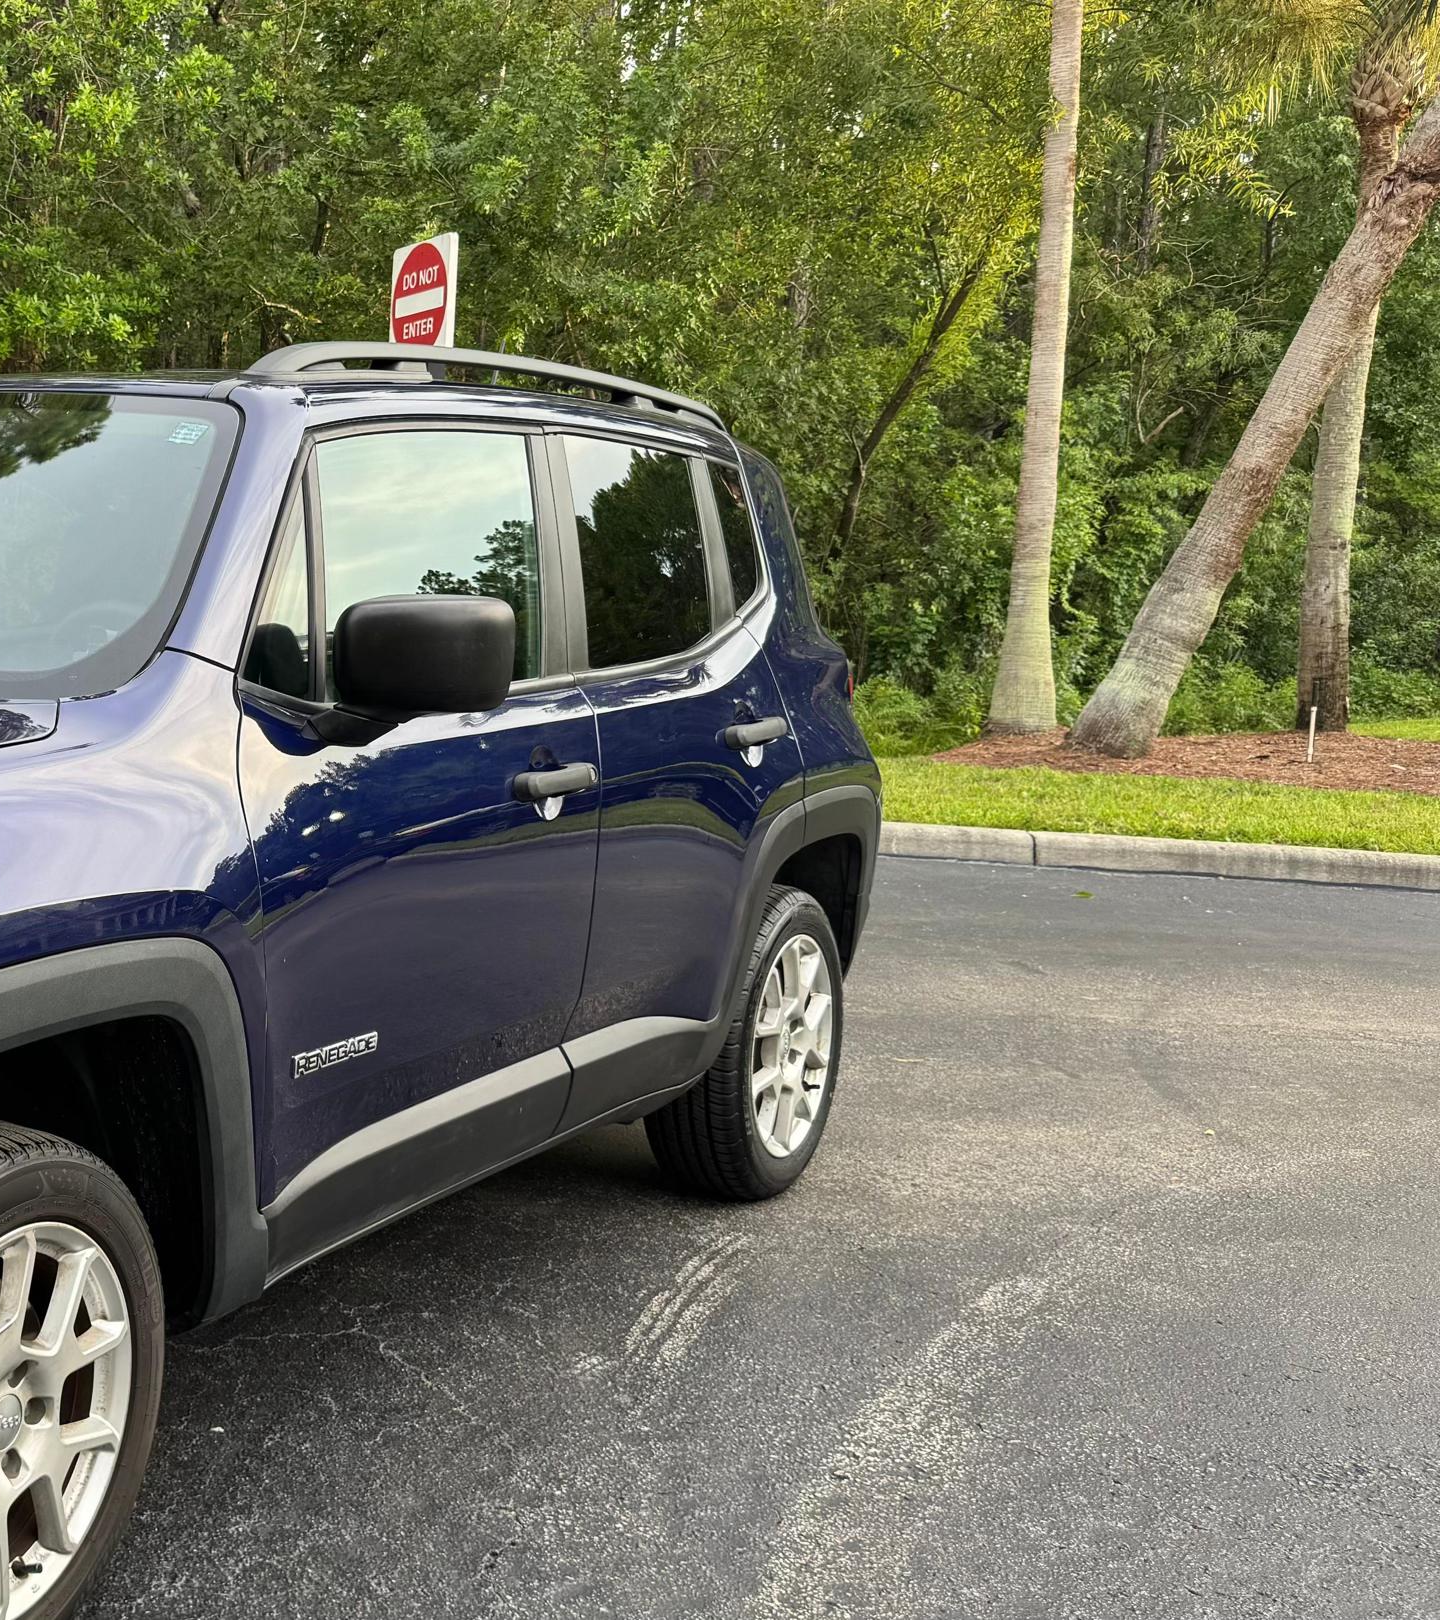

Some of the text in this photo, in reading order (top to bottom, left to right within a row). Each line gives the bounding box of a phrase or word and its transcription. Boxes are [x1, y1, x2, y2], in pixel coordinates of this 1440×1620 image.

[403, 265, 439, 291] DO NOT
[403, 318, 434, 340] ENTER
[291, 1031, 378, 1079] RENEGADE
